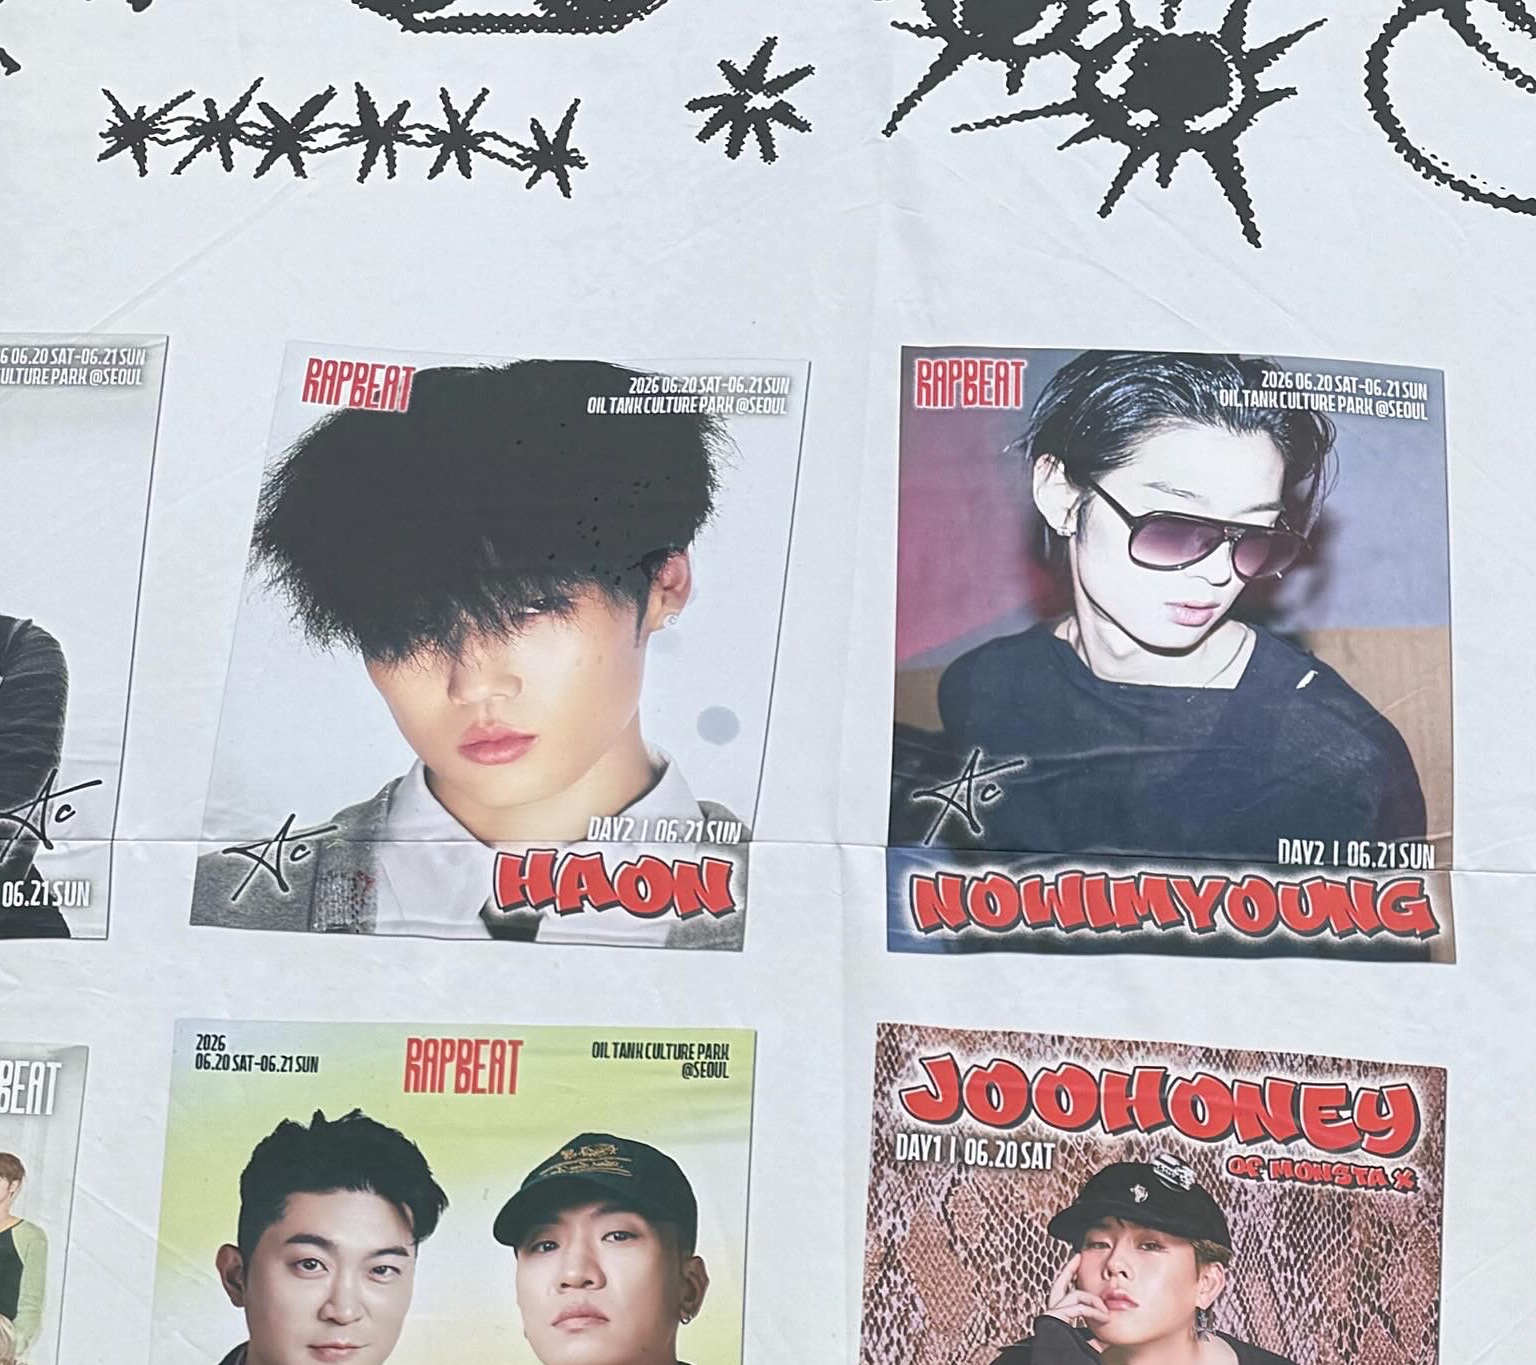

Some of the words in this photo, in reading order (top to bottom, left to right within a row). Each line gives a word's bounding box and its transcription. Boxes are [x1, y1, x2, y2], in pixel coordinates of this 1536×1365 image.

[301, 357, 416, 412] RAPBEAT
[915, 358, 1026, 408] RAPBEAT
[1278, 839, 1325, 866] DAY2
[1346, 841, 1397, 868] 06.21
[1399, 842, 1435, 869] SUN
[1, 880, 49, 909] 06.21
[51, 880, 91, 908] SUN
[0, 1059, 62, 1116] BEAT
[404, 1037, 524, 1095] RAPBEAT
[896, 1133, 942, 1164] DAY1
[963, 1137, 1020, 1168] 06.20
[1020, 1141, 1056, 1172] SAT
